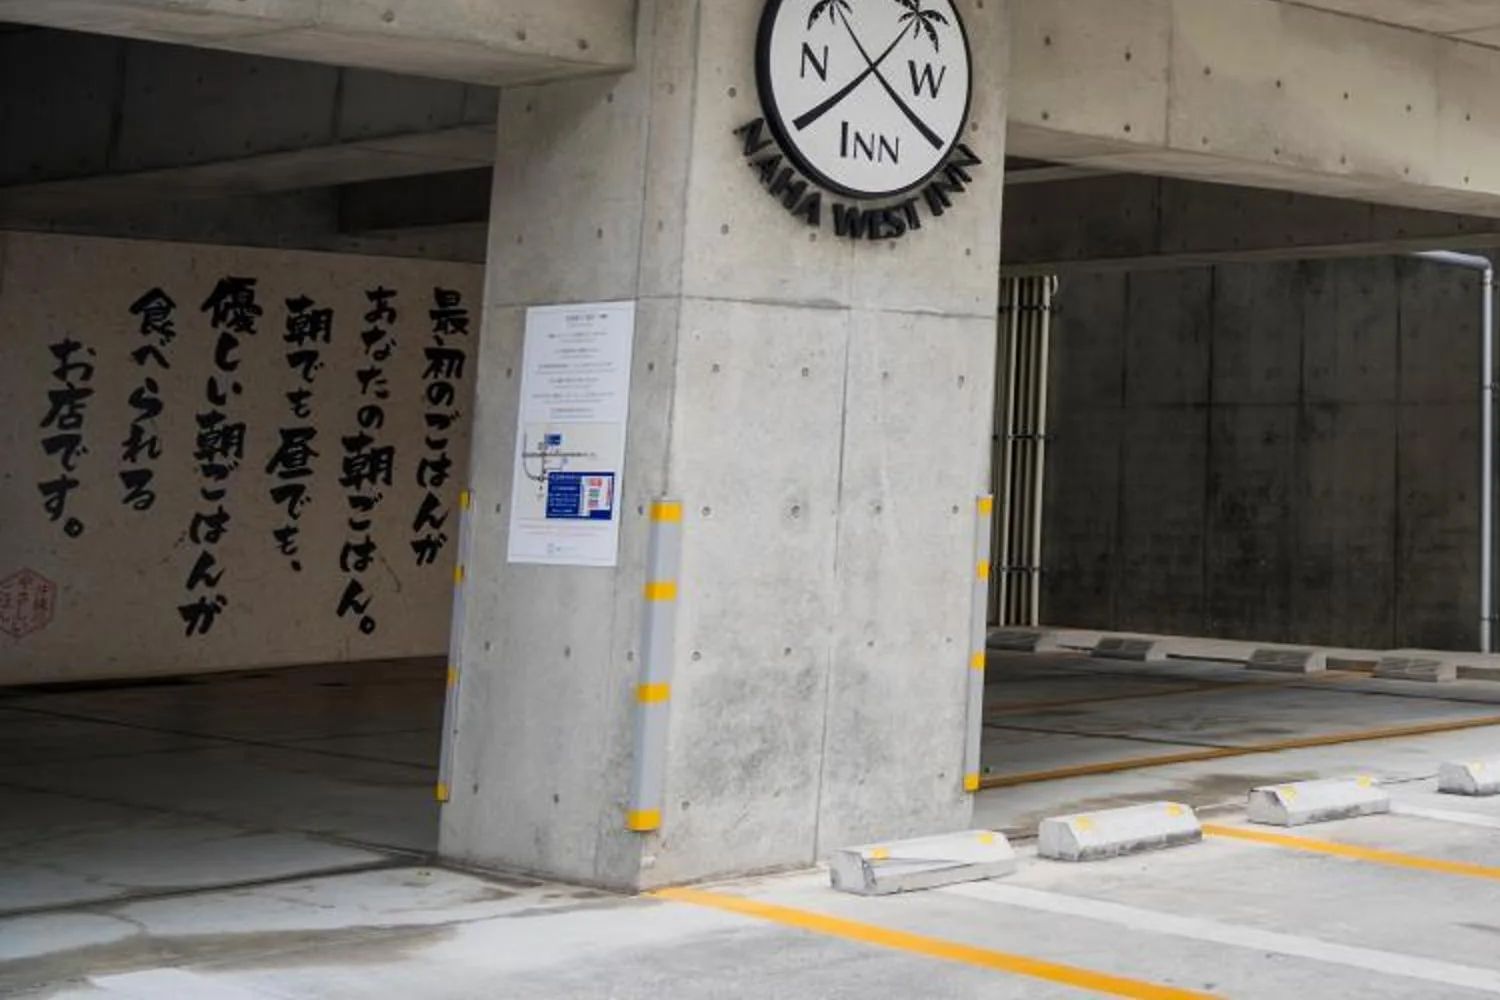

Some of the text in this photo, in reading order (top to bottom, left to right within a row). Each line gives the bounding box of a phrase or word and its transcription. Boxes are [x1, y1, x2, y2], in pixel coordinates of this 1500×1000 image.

[733, 117, 982, 240] NAHA WEST INN
[800, 42, 946, 99] N W
[840, 121, 899, 165] INN
[38, 338, 96, 537] お店です。
[119, 287, 177, 510] 食べられる
[178, 277, 263, 636] 優しい朝ごはんが
[267, 295, 333, 572] 朝でも昼でも、
[337, 286, 397, 635] あなたの朝ごはん。
[411, 287, 469, 566] 最初のごはんが
